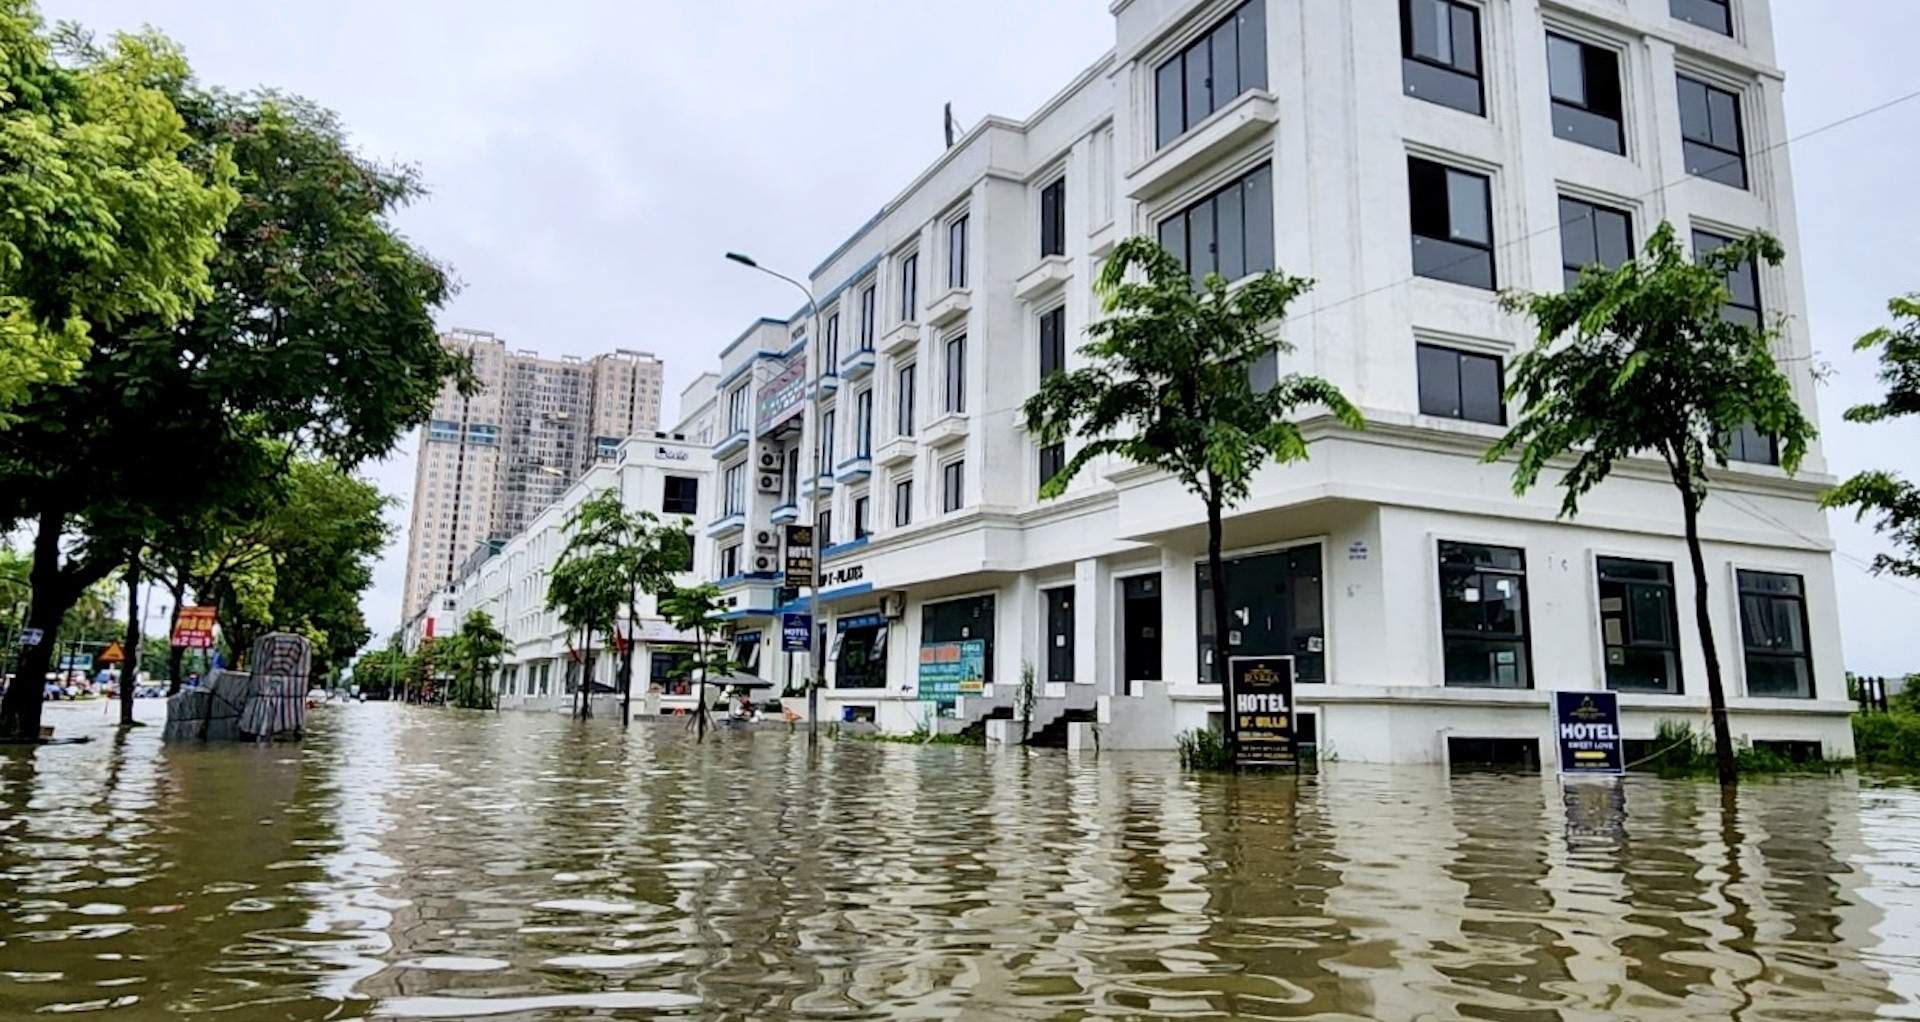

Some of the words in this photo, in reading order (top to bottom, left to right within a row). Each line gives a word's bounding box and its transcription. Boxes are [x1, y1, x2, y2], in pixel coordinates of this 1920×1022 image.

[788, 546, 814, 558] HOTE
[784, 627, 809, 637] HOTEL
[1237, 693, 1289, 713] HOTEL
[1560, 723, 1619, 740] HOTEL
